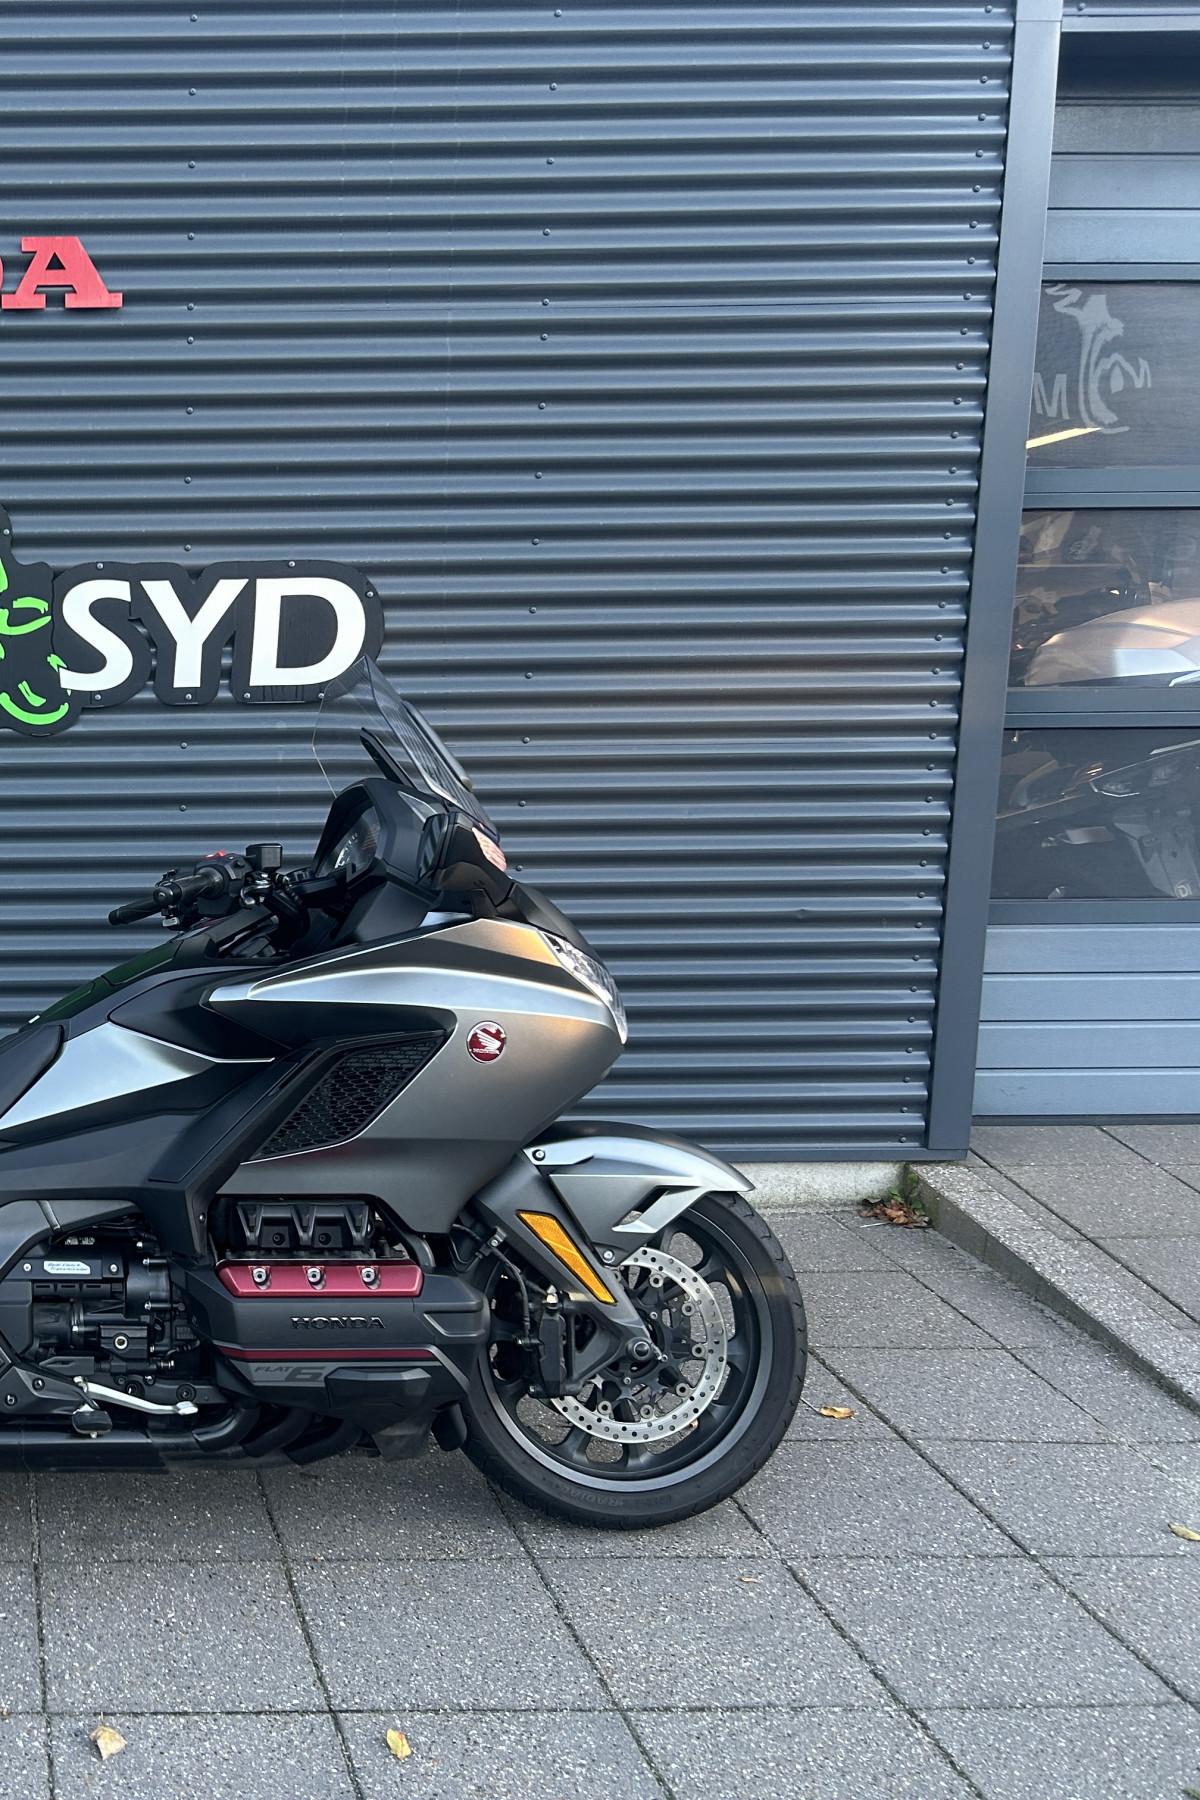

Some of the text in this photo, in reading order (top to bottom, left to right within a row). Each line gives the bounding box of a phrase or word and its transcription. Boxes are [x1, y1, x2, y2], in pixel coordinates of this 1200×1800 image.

[59, 576, 367, 692] SYD
[290, 1316, 386, 1330] HONDA
[285, 1366, 326, 1383] 6
